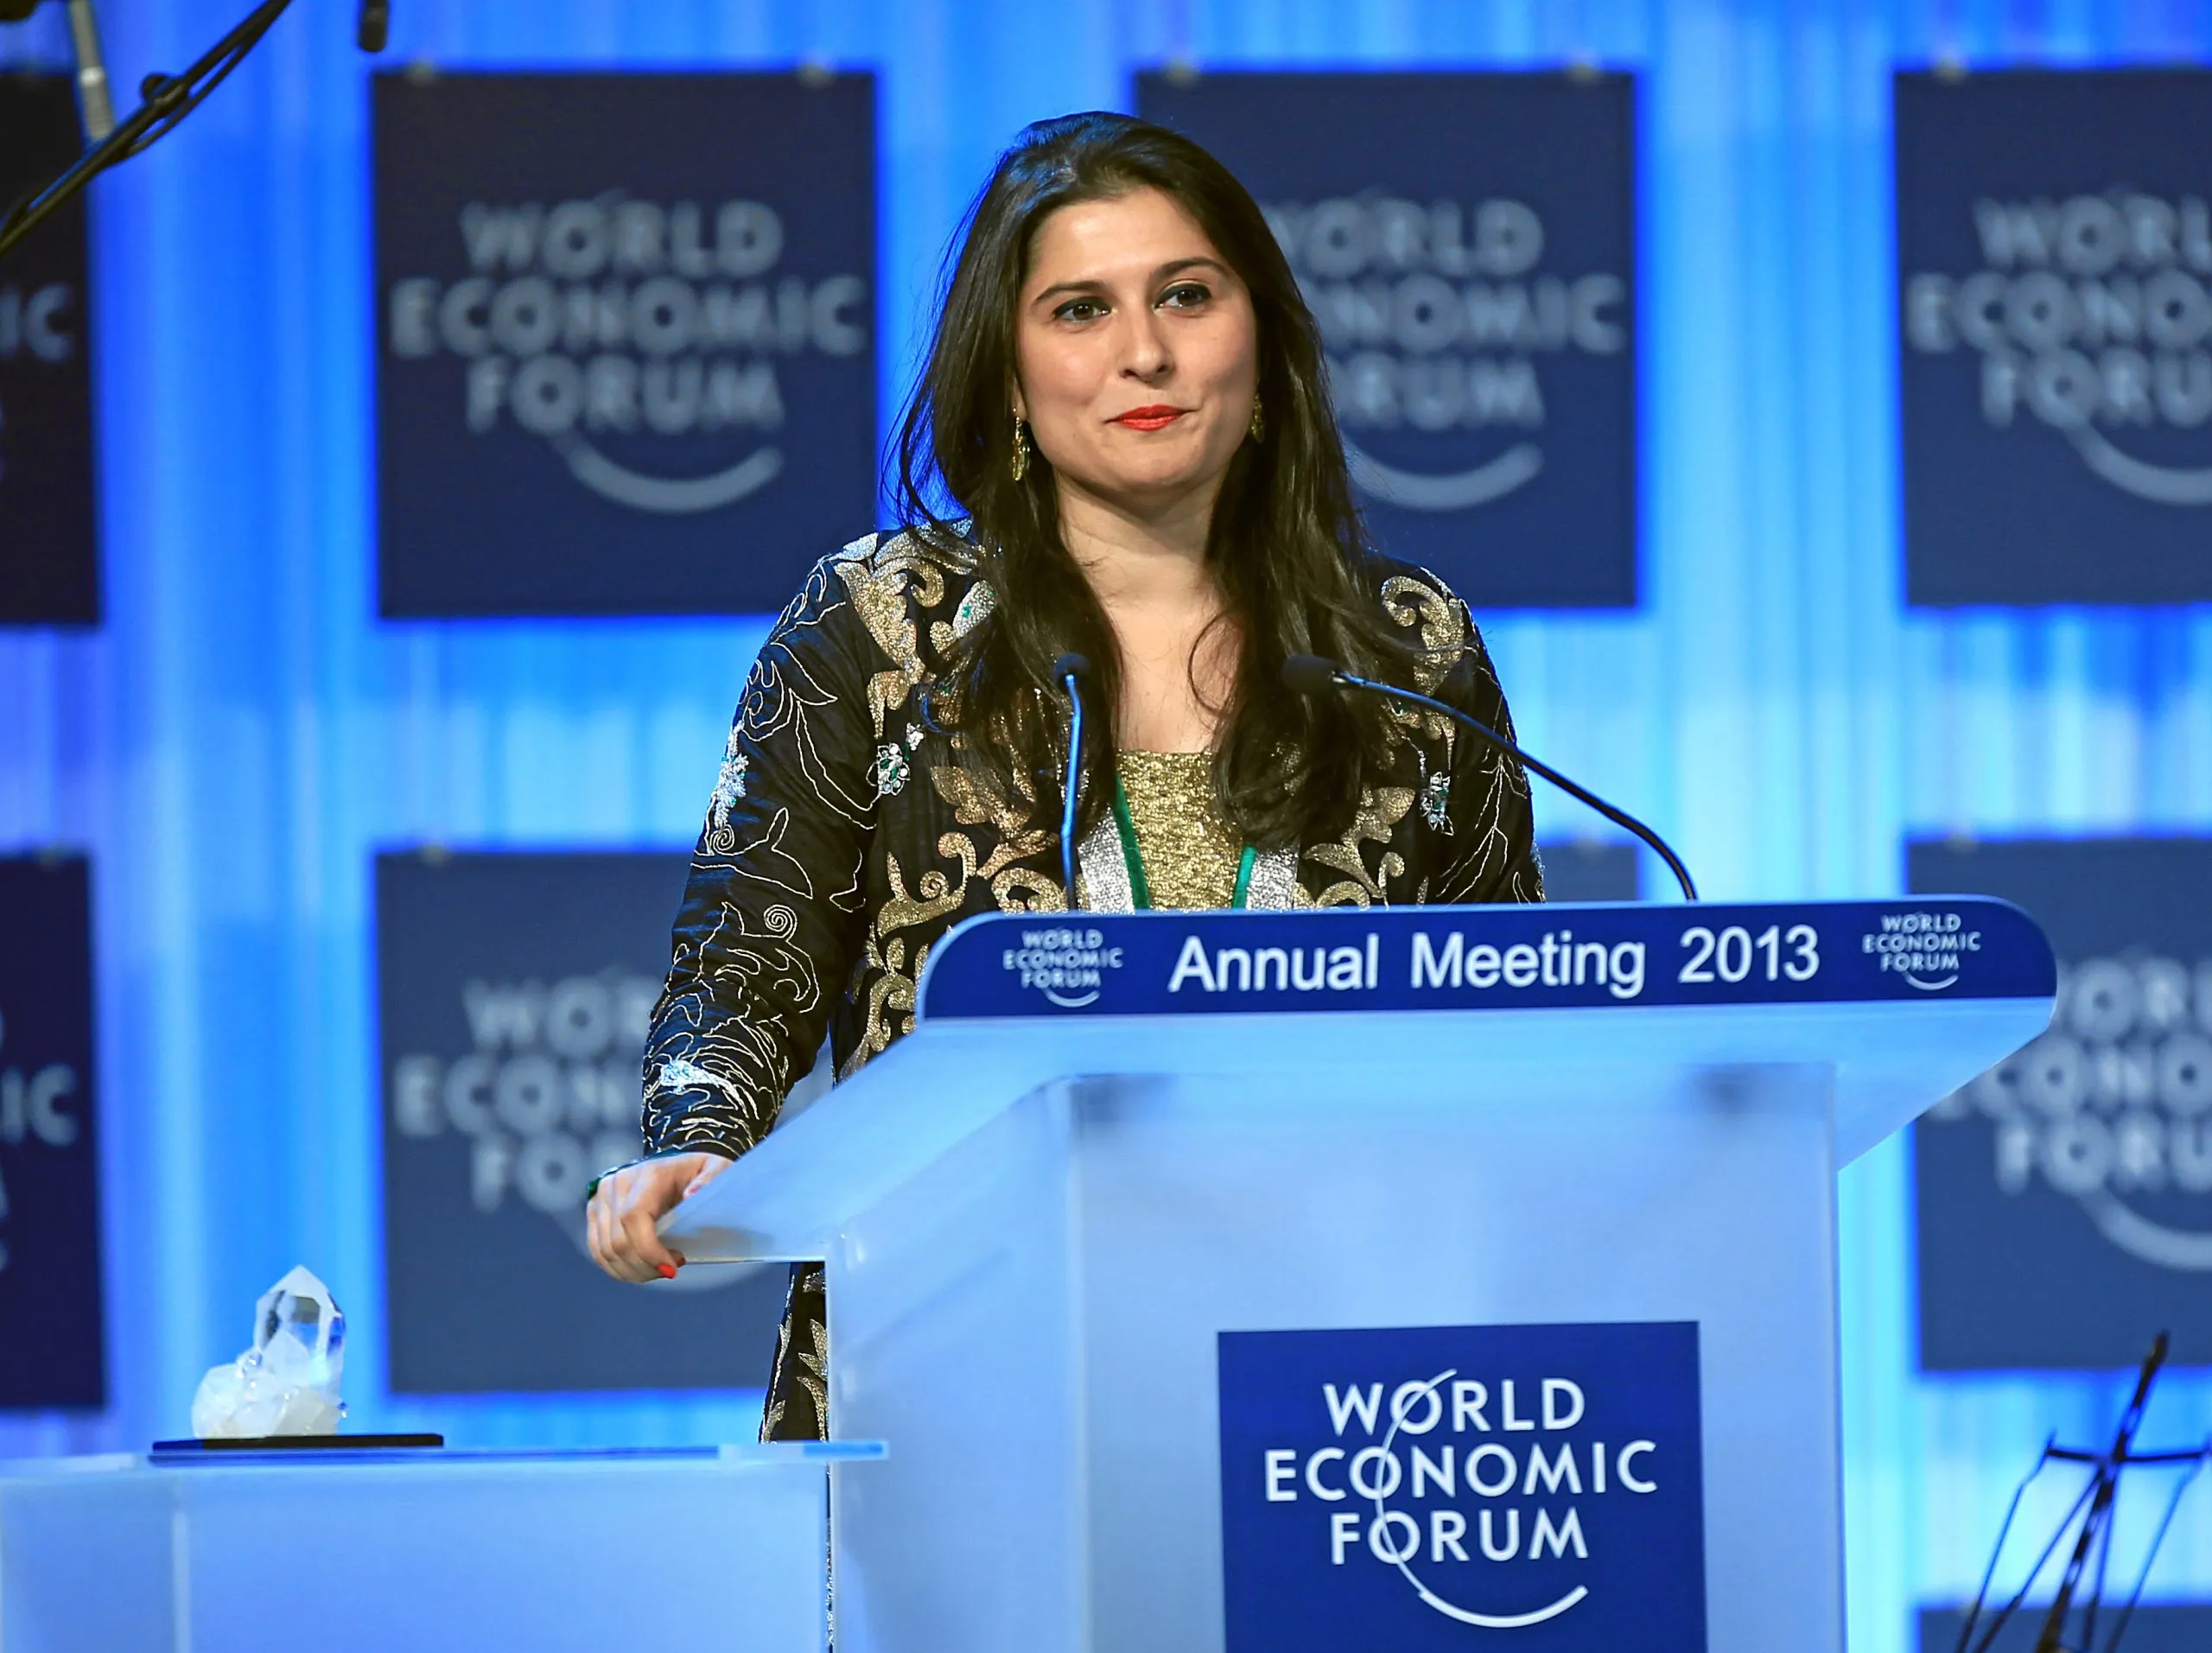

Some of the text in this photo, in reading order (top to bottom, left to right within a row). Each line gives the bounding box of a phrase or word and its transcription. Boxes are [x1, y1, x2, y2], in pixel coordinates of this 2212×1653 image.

[461, 200, 784, 277] WORLD
[1972, 195, 2212, 275] WORL
[390, 275, 864, 357] ECONOMIC
[1298, 274, 1628, 354] NOMIC
[1908, 271, 2212, 354] ECONO
[466, 356, 785, 433] FORUM
[1328, 352, 1545, 430] RUM
[1981, 349, 2212, 429] FORU
[1002, 947, 1124, 970] ECONOMIC
[1021, 929, 1103, 950] WORLD
[1861, 931, 1981, 954] ECONOMIC
[1880, 912, 1961, 934] WORLD
[1020, 968, 1102, 989] FORUM
[1168, 924, 1820, 999] Annual Meeting 2013
[1879, 951, 1960, 972] FORUM
[463, 976, 664, 1058] WOR
[1996, 1113, 2212, 1195] FORU
[1323, 1378, 1586, 1436] WORLD
[1264, 1440, 1657, 1503] ECONOMIC
[1331, 1506, 1589, 1566] FORUM
